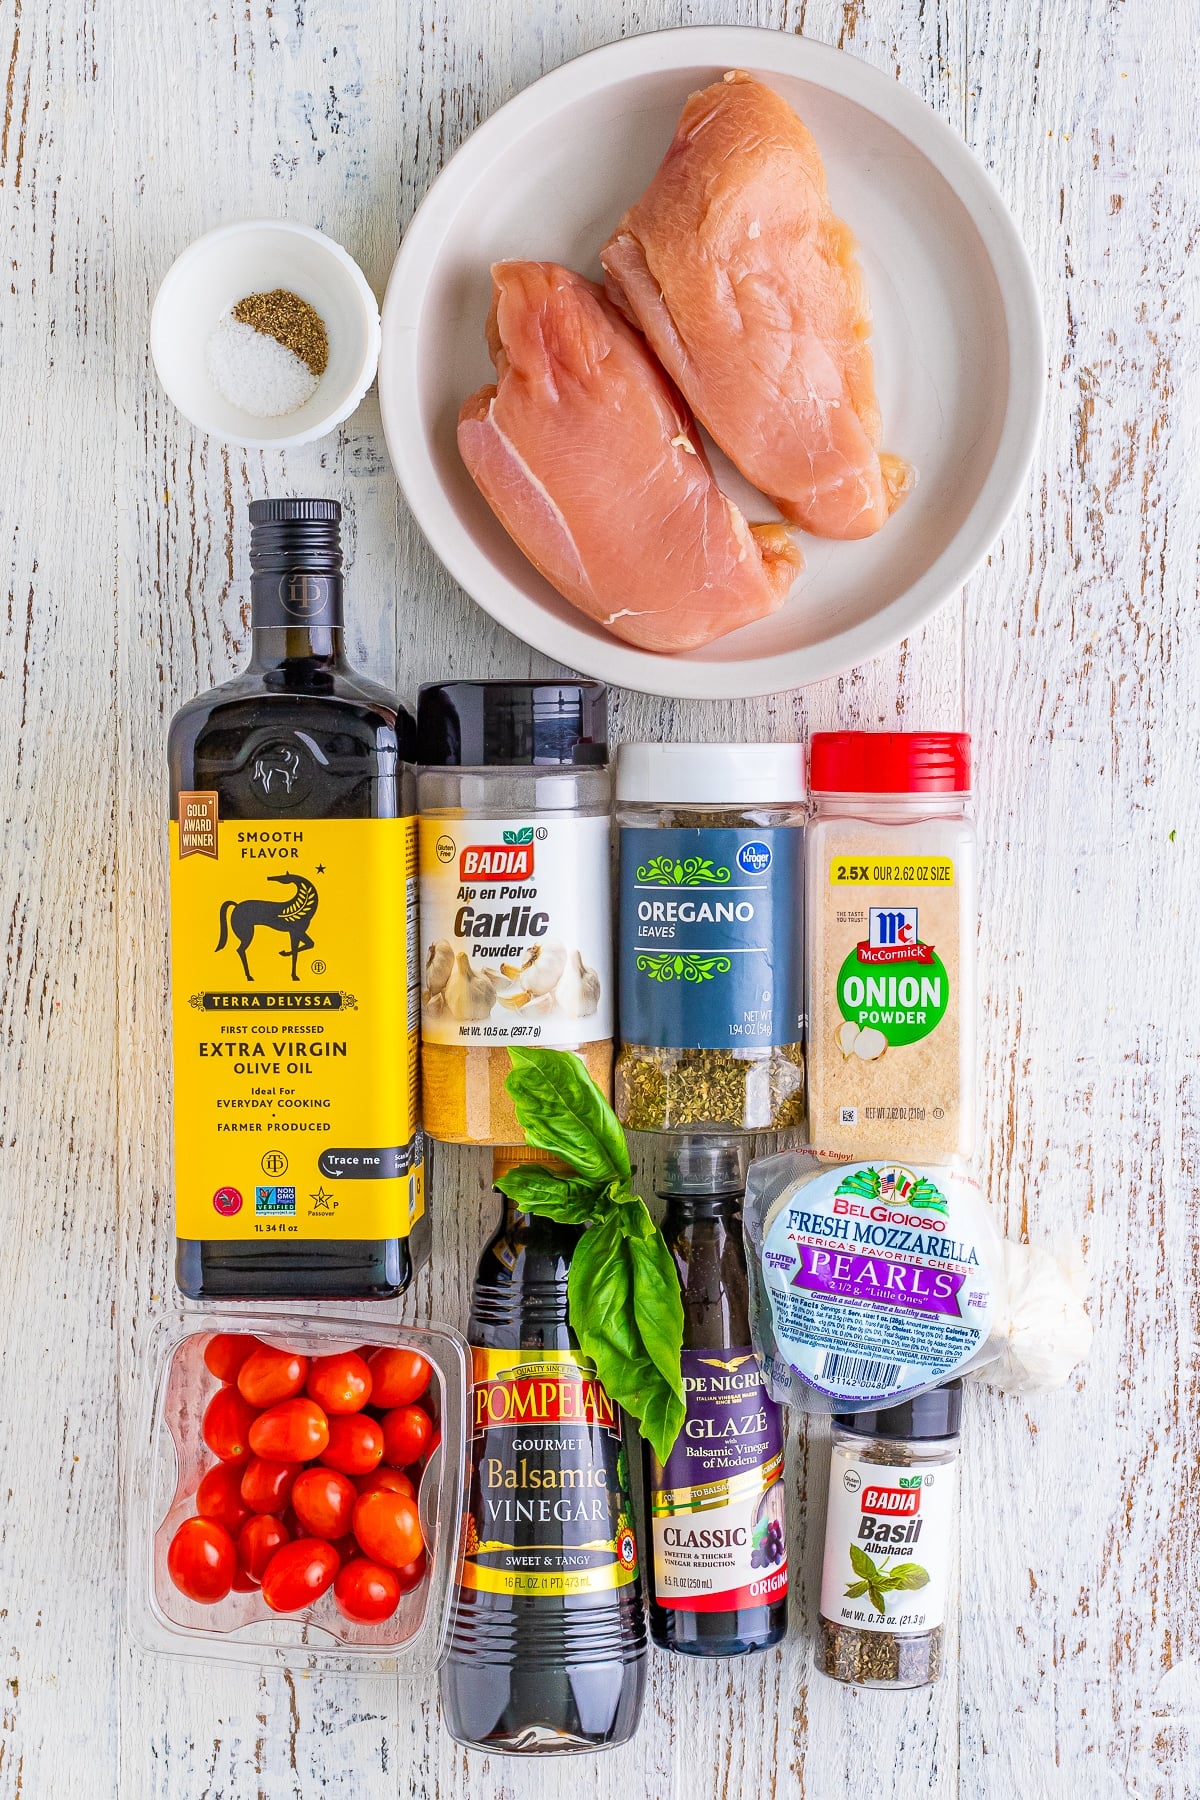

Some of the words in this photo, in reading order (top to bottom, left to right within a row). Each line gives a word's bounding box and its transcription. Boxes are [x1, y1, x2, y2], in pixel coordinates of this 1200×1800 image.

[187, 804, 207, 817] GOLD
[184, 819, 212, 832] AWARD
[182, 834, 214, 847] WINNER
[238, 832, 304, 843] SMOOTH
[241, 848, 299, 858] FLAVOR
[437, 844, 454, 852] Gluten
[464, 850, 528, 874] BADIA
[742, 847, 769, 870] Kroger
[837, 866, 870, 880] 2.5X
[874, 866, 892, 880] OUR
[894, 866, 914, 880] 2.62
[916, 866, 928, 880] OZ
[930, 866, 950, 880] SIZE
[456, 886, 476, 903] Ajo
[480, 889, 496, 899] en
[500, 886, 538, 899] Polvo
[637, 901, 755, 923] OREGANO
[454, 906, 550, 938] Garlic
[638, 925, 676, 938] LEAVES
[472, 944, 524, 958] Powder
[860, 946, 926, 961] McCormick
[843, 976, 941, 1008] ONION
[212, 996, 260, 1006] TERRA
[266, 996, 332, 1006] DELYSSA
[744, 1010, 758, 1022] NET
[760, 1010, 772, 1021] WT
[858, 1012, 926, 1024] POWDER
[220, 1026, 248, 1034] FIRST
[251, 1026, 278, 1034] COLD
[282, 1026, 324, 1034] PRESSED
[459, 1026, 470, 1036] Net
[471, 1026, 482, 1036] Wt.
[483, 1026, 498, 1036] 10.5
[510, 1026, 534, 1038] (297.7
[534, 1025, 542, 1038] g)
[744, 1024, 756, 1035] OZ
[758, 1021, 772, 1037] (54g)
[200, 1042, 266, 1057] EXTRA
[272, 1042, 347, 1057] VIRGIN
[234, 1062, 280, 1074] OLIVE
[286, 1062, 312, 1074] OIL
[251, 1087, 276, 1096] Ideal
[280, 1087, 296, 1096] For
[216, 1100, 273, 1108] EVERYDAY
[277, 1100, 331, 1108] COOKING
[866, 1108, 876, 1119] NET
[876, 1108, 886, 1119] WT
[900, 1108, 907, 1119] OZ
[908, 1107, 926, 1120] (216g)
[217, 1123, 262, 1132] FARMER
[267, 1123, 331, 1132] PRODUCED
[328, 1156, 359, 1164] Trace
[828, 1150, 854, 1161] Enjoy!
[254, 1224, 264, 1232] 1L
[266, 1224, 276, 1232] 34
[278, 1224, 286, 1232] fl
[786, 1208, 850, 1240] FRESH
[852, 1222, 980, 1266] MOZZARELLA
[764, 1252, 796, 1264] GLUTEN
[787, 1232, 856, 1252] AMERICA'S
[861, 1247, 923, 1265] FAVORITE
[928, 1259, 975, 1275] CHEESE
[770, 1260, 790, 1270] FREE
[808, 1250, 954, 1298] PEARLS
[838, 1282, 852, 1292] 1/2
[853, 1287, 862, 1295] g.
[810, 1292, 838, 1302] Garnish
[844, 1298, 861, 1307] salad
[872, 1302, 888, 1312] have
[894, 1306, 920, 1318] healthy
[920, 1312, 940, 1321] snack
[800, 1300, 818, 1309] Facts
[946, 1327, 968, 1337] Calories
[833, 1338, 848, 1346] FROM
[848, 1341, 882, 1352] PASTEURIZED
[516, 1366, 544, 1375] QUALITY
[683, 1377, 708, 1392] DE
[830, 1376, 857, 1387] 31142
[475, 1382, 614, 1424] POMPEIAN
[685, 1406, 768, 1439] GLAZÉ
[512, 1440, 584, 1451] GOURMET
[686, 1446, 733, 1457] Balsamic
[735, 1441, 770, 1455] Vinegar
[703, 1458, 716, 1469] of
[717, 1455, 758, 1468] Modena
[487, 1458, 607, 1489] Balsamic
[865, 1490, 916, 1511] BADIA
[486, 1500, 606, 1522] VINEGAR
[857, 1515, 923, 1543] Basil
[663, 1528, 747, 1548] CLASSIC
[664, 1550, 692, 1559] SWEETER
[700, 1552, 733, 1560] THICKER
[863, 1542, 914, 1556] Albahaca
[506, 1556, 542, 1566] SWEET
[544, 1557, 553, 1566] &
[554, 1556, 590, 1566] TANGY
[664, 1558, 691, 1567] VINEGAR
[504, 1577, 514, 1588] 16
[515, 1578, 526, 1588] FL.
[528, 1578, 540, 1588] OZ.
[542, 1578, 548, 1588] (1
[564, 1576, 580, 1588] 473
[580, 1576, 592, 1586] mL
[680, 1578, 687, 1588] OZ
[687, 1578, 700, 1588] (250
[702, 1578, 712, 1589] mL)
[841, 1608, 852, 1619] Net
[854, 1610, 866, 1622] Wt.
[868, 1613, 885, 1624] 0.75
[886, 1616, 897, 1625] oz.
[900, 1614, 919, 1626] (21.3
[919, 1613, 926, 1626] g)
